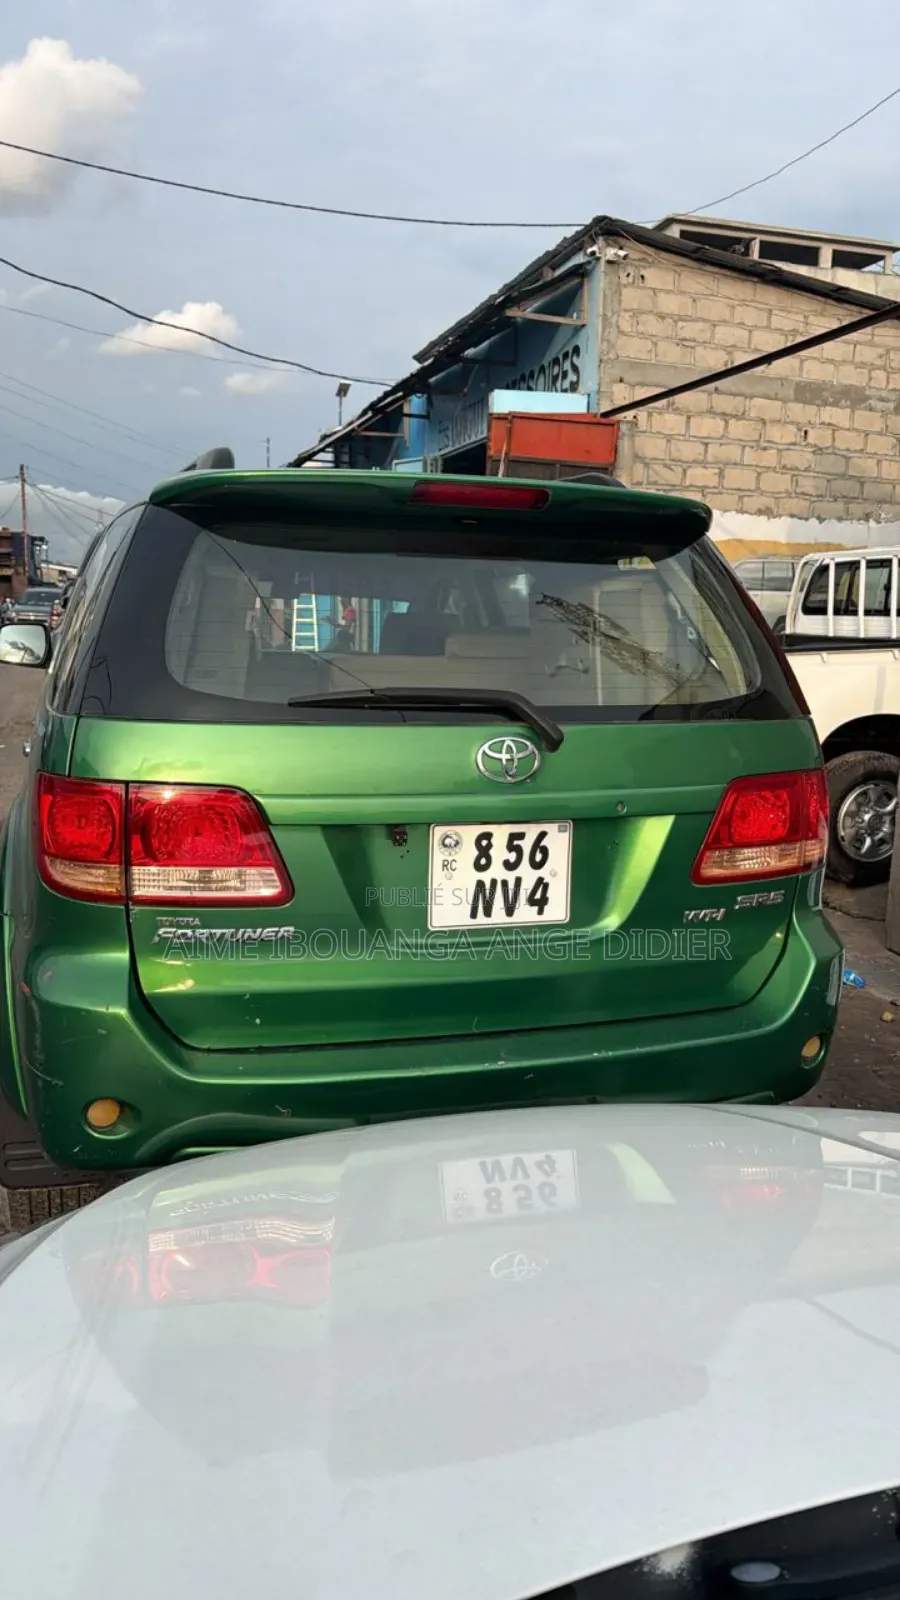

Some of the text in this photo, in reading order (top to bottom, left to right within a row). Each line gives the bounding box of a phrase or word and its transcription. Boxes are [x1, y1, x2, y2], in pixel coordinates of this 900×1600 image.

[442, 859, 457, 871] RC
[156, 916, 201, 926] TOYOTA
[151, 926, 295, 944] FORTUNER
